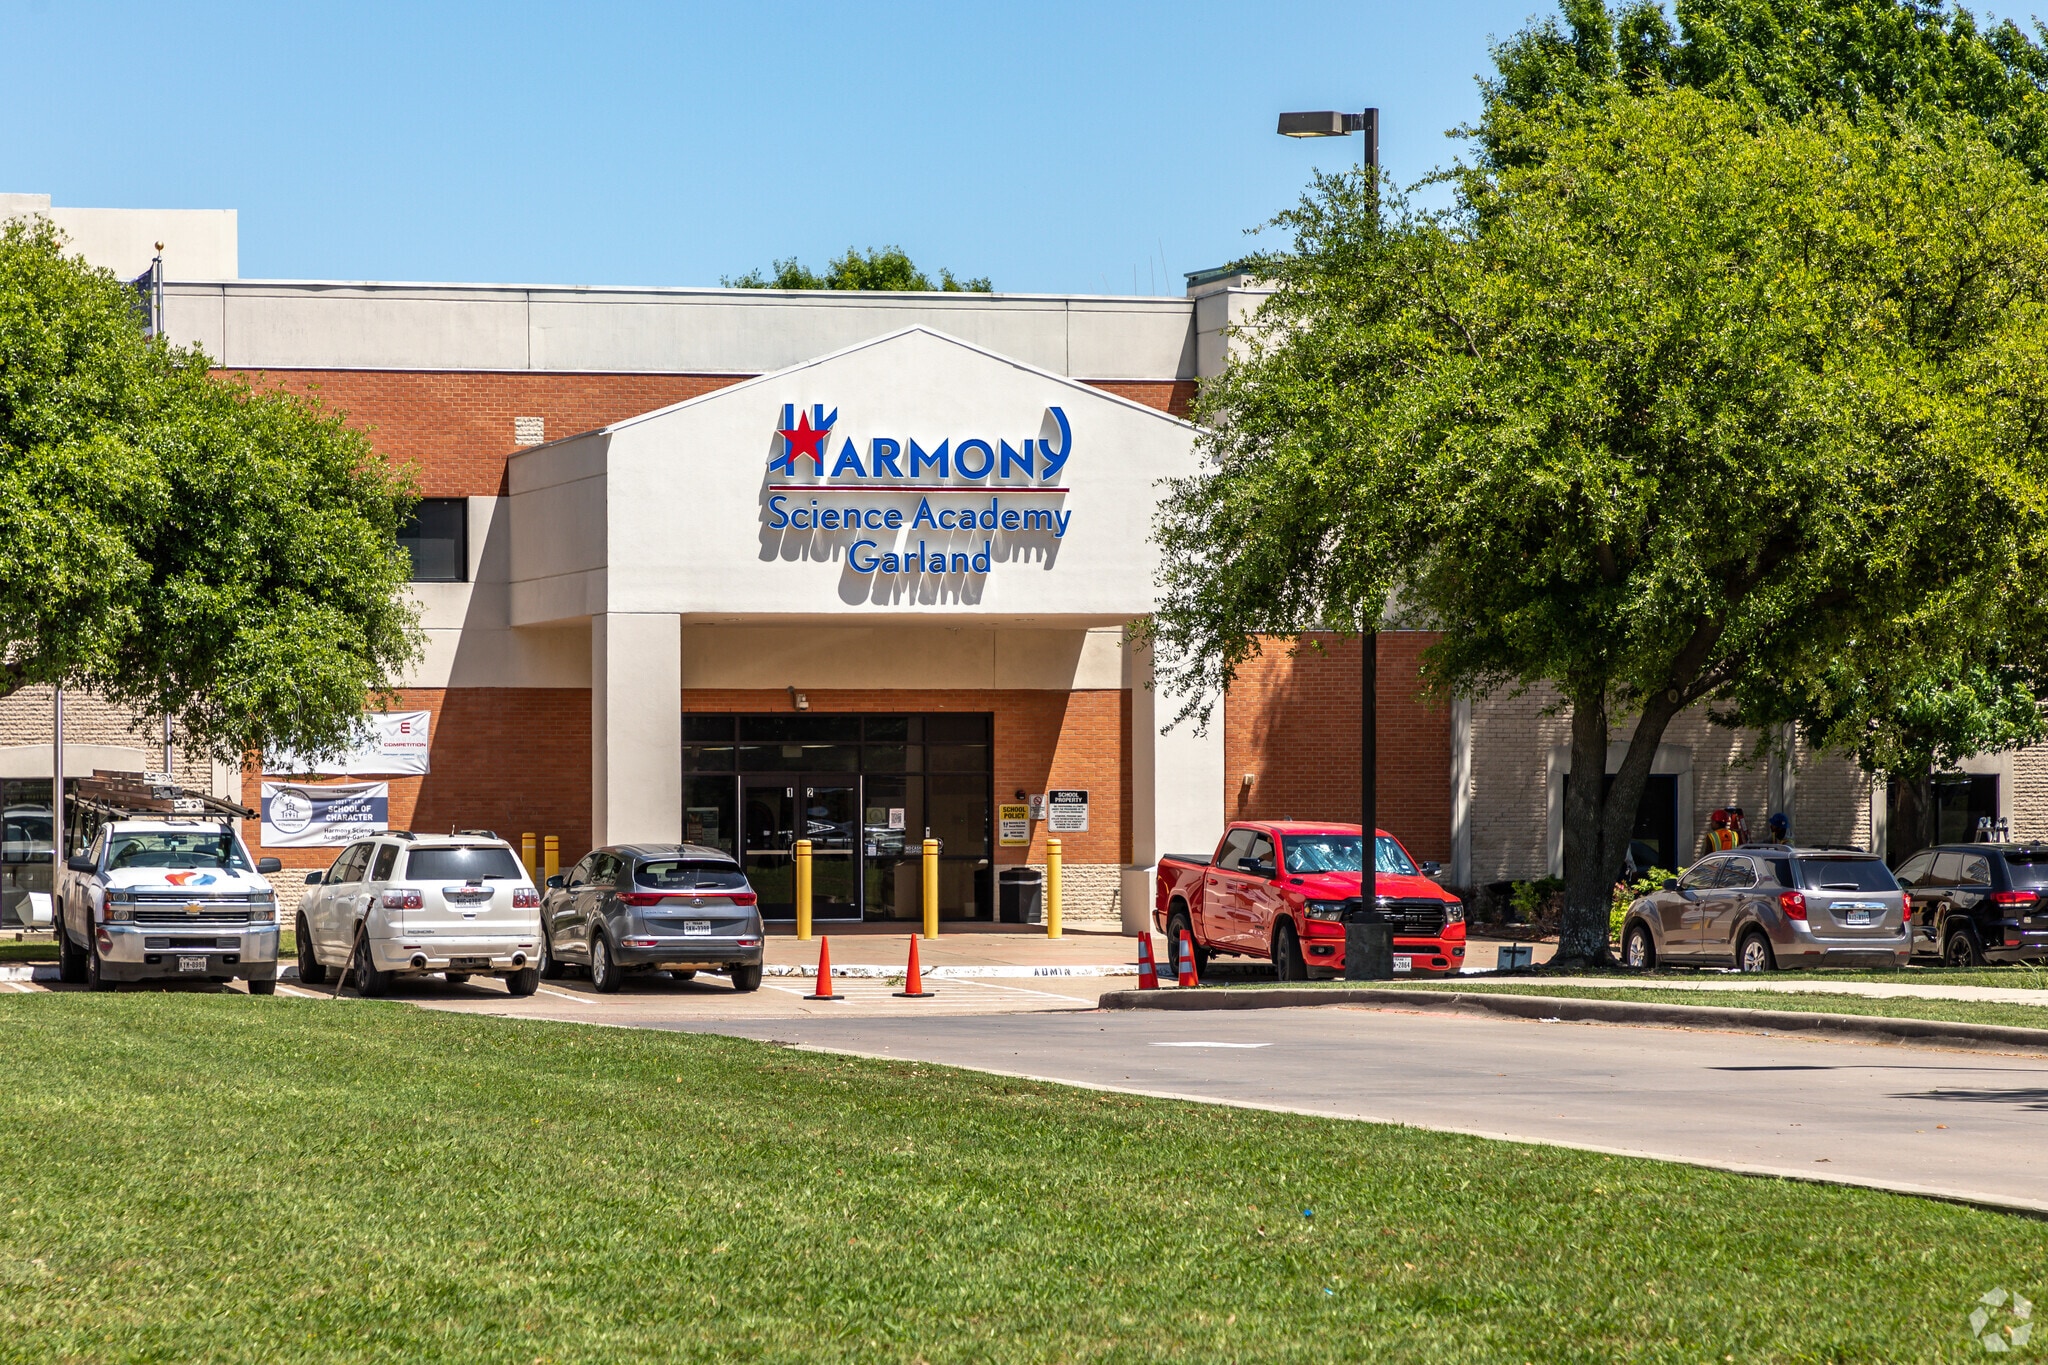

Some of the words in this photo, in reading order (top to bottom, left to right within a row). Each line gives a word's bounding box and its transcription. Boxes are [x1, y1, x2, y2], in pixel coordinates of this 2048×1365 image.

[769, 403, 1073, 481] HARMONY
[769, 495, 903, 530] Science
[912, 495, 1072, 537] Academy
[848, 540, 991, 574] Garland
[325, 813, 373, 821] CHARACTER
[327, 805, 360, 813] SCHOOL
[360, 804, 371, 812] OF
